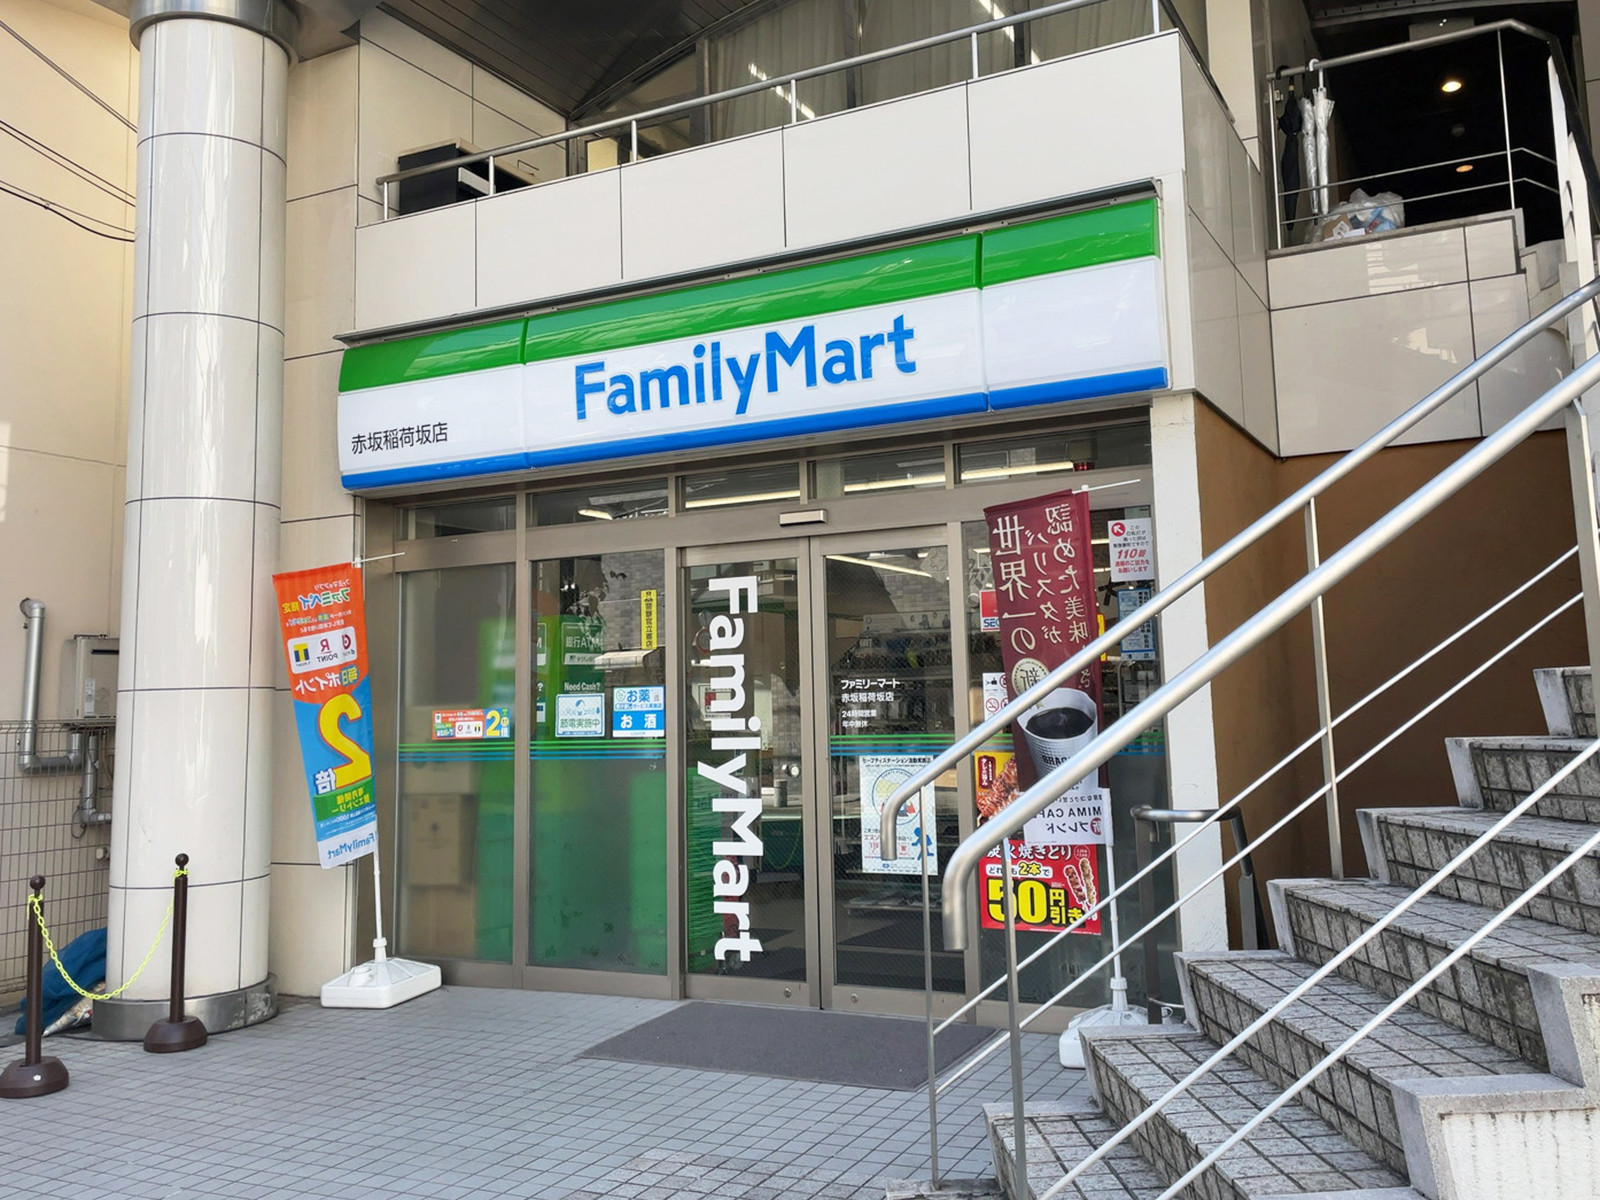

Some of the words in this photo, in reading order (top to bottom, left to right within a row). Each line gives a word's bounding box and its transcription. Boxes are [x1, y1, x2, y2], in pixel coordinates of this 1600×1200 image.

[575, 314, 917, 421] FamilyMart
[351, 422, 448, 455] 赤坂稲荷坂店
[1117, 548, 1147, 560] 110番
[983, 617, 1000, 628] SEC
[565, 635, 601, 649] 銀行ATM
[564, 682, 581, 691] Need
[581, 682, 600, 691] Cash?
[840, 678, 900, 690] ファミリーマート
[626, 689, 651, 703] お薬
[841, 691, 894, 703] 赤坂稲荷坂店
[841, 709, 877, 718] 24時間営業
[560, 717, 600, 729] 節電実施中
[620, 713, 657, 729] お酒
[841, 720, 869, 728] 年中無休
[697, 575, 764, 962] FamilyMart
[988, 860, 1050, 877] どれも2本で
